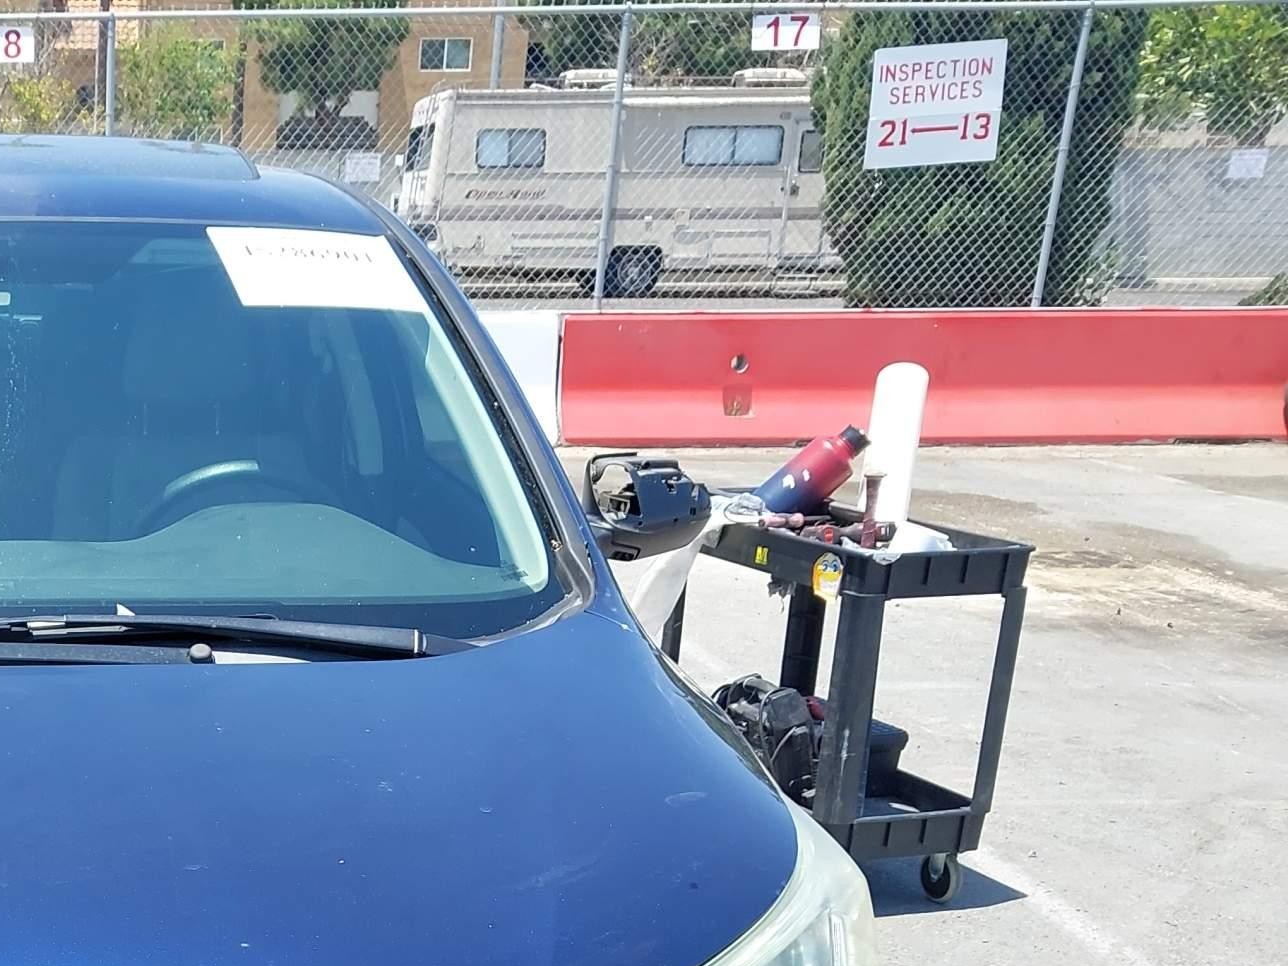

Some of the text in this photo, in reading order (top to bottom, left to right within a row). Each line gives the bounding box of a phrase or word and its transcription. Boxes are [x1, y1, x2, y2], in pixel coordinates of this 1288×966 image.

[766, 15, 810, 47] 17
[879, 57, 993, 83] INSPECTION
[889, 80, 983, 105] SERVICES
